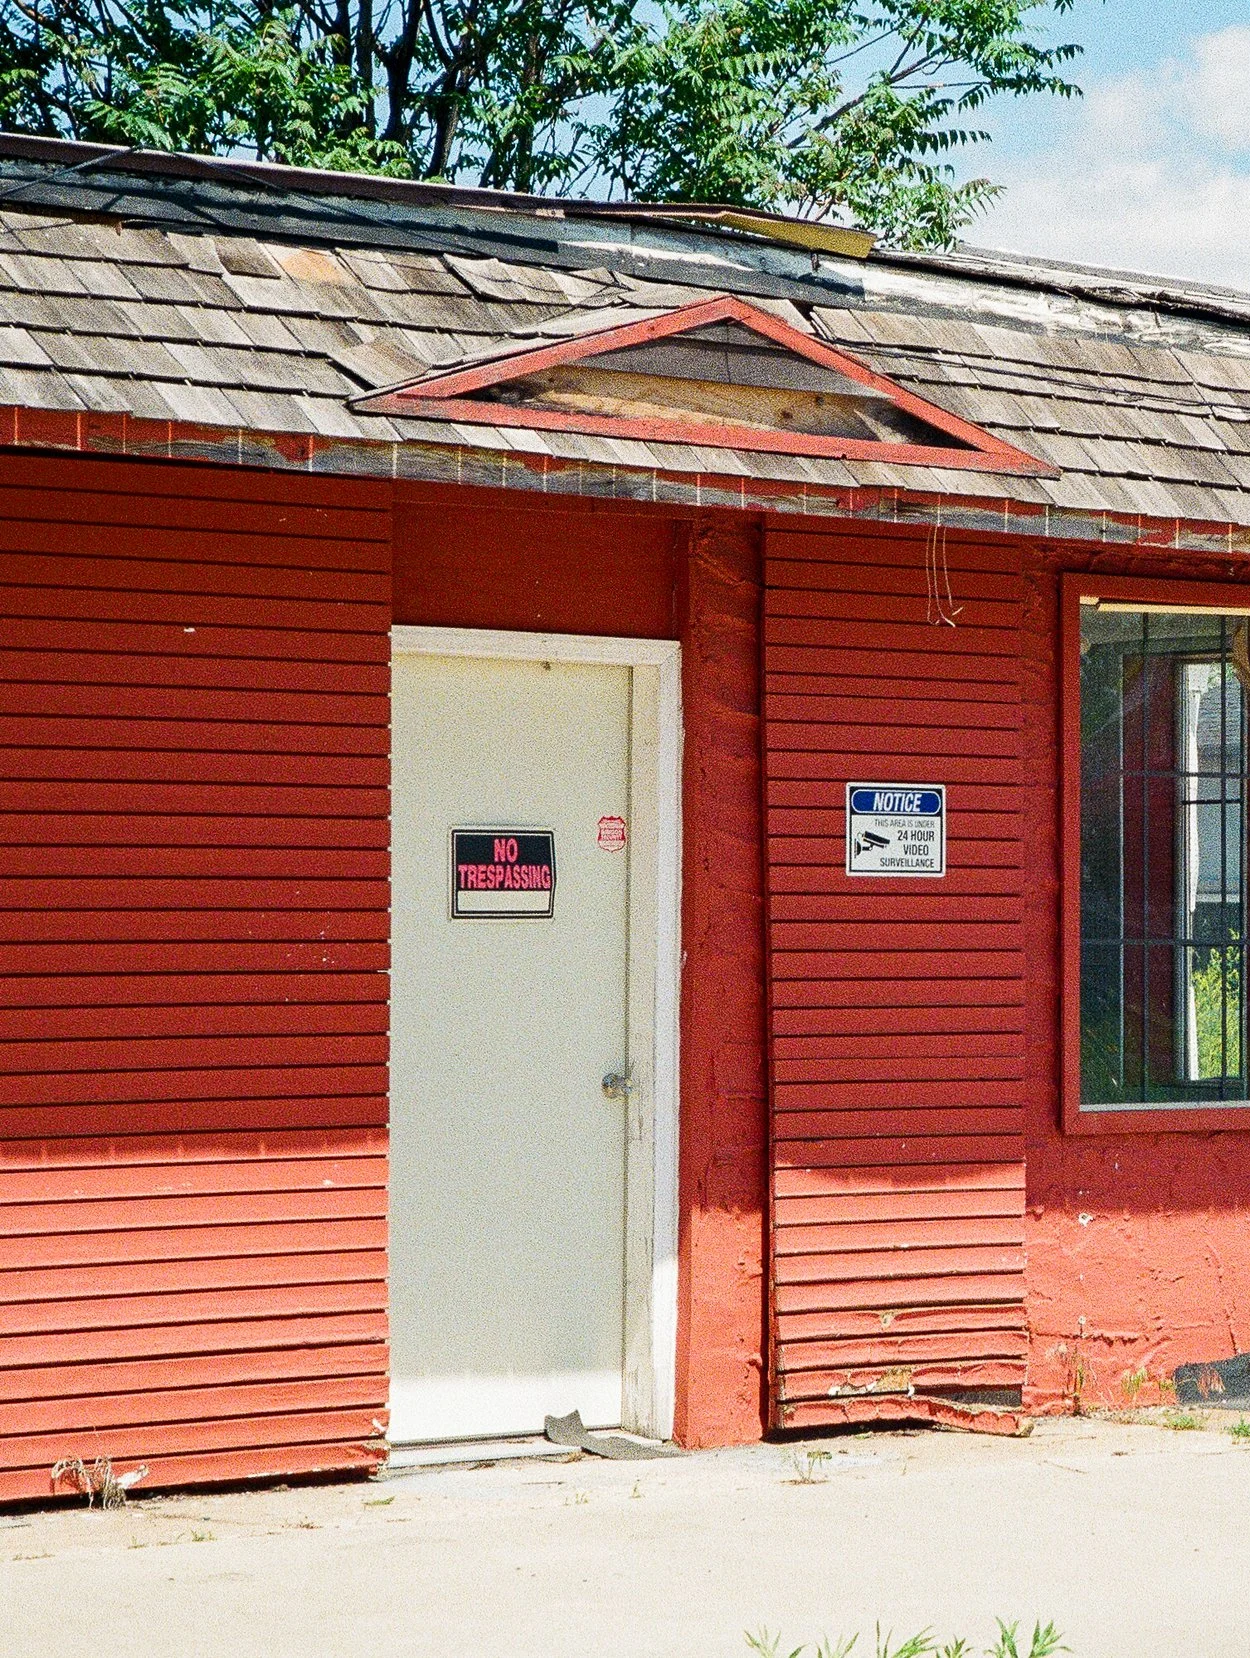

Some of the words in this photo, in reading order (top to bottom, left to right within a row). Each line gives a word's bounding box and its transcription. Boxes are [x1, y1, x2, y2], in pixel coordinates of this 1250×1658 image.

[873, 792, 922, 812] NOTICE
[875, 819, 889, 827] THIS
[890, 819, 907, 828] AREA
[907, 819, 913, 828] IS
[914, 820, 935, 828] UNDER
[897, 830, 909, 841] 24
[911, 830, 935, 842] HOUR
[493, 838, 518, 863] NO
[903, 844, 929, 856] VIDEO
[880, 857, 935, 868] SURVEILLANCE
[457, 864, 551, 889] TRESPASSING
